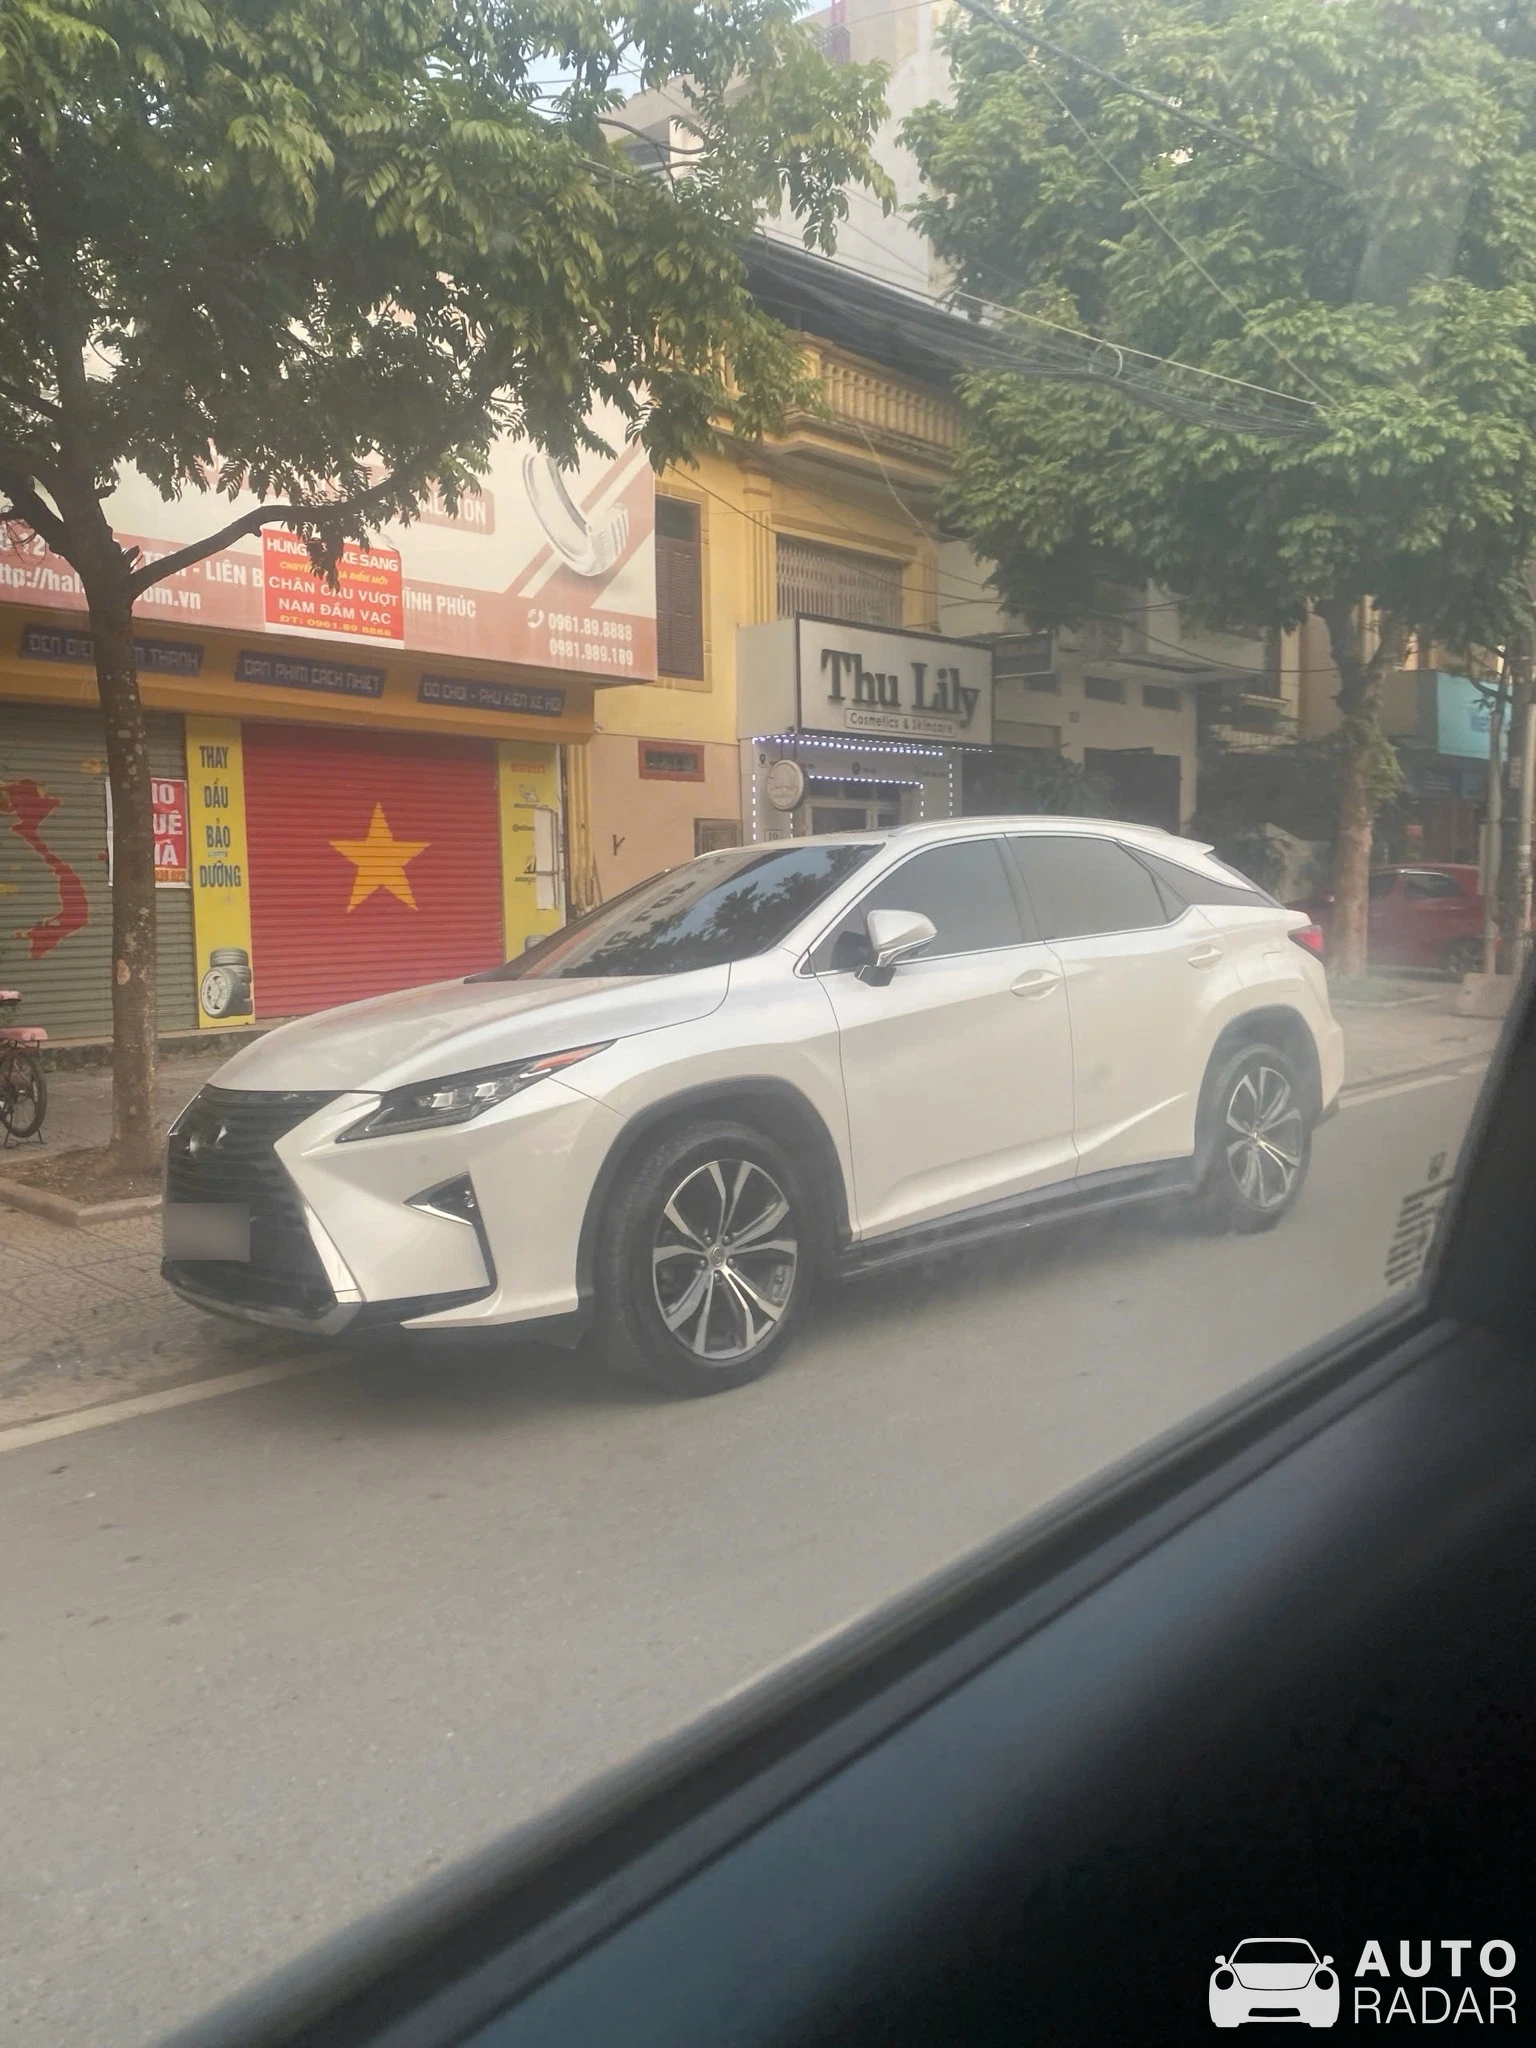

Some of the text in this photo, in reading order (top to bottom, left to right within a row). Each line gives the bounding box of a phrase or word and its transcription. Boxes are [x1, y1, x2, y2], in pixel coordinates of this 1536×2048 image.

[360, 554, 398, 572] SANG
[206, 559, 247, 586] LIÊN
[402, 586, 432, 613] ĨNH
[436, 594, 476, 618] PHÚC
[268, 576, 316, 594] CHÂN
[358, 590, 399, 607] VƯỢT
[278, 598, 315, 614] NAM
[360, 609, 392, 625] VẠC
[821, 648, 982, 728] Thu Lily
[850, 712, 898, 729] Cosmetics
[199, 745, 229, 769] THAY
[205, 818, 231, 848] BẢO
[199, 860, 242, 888] DƯỠNG
